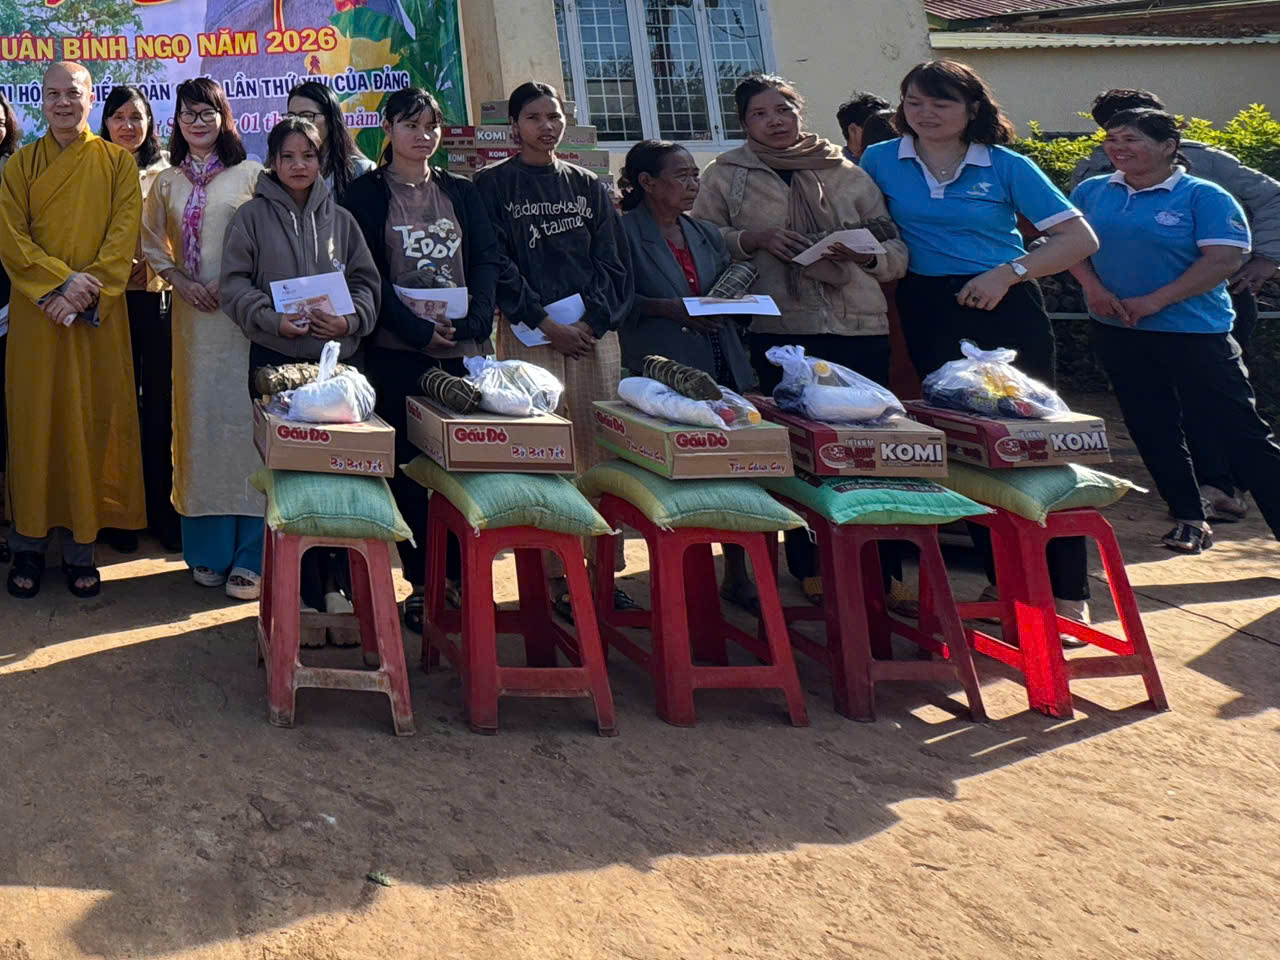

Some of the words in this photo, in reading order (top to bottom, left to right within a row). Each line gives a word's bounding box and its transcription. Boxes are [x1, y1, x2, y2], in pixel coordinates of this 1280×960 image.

[63, 31, 127, 60] BÍNH
[136, 35, 191, 63] NGỌ
[198, 28, 258, 57] NĂM
[266, 27, 336, 54] 2026
[21, 80, 44, 107] HỘ
[225, 72, 256, 98] LẦN
[334, 66, 369, 92] CỦA
[373, 66, 409, 90] ĐẢNG
[240, 113, 260, 132] 01
[344, 107, 379, 127] năm
[477, 131, 505, 140] KOMI
[448, 153, 464, 163] KOMI
[392, 225, 461, 258] TEDDY
[880, 442, 943, 462] KOMI
[1050, 431, 1109, 452] KOMI
